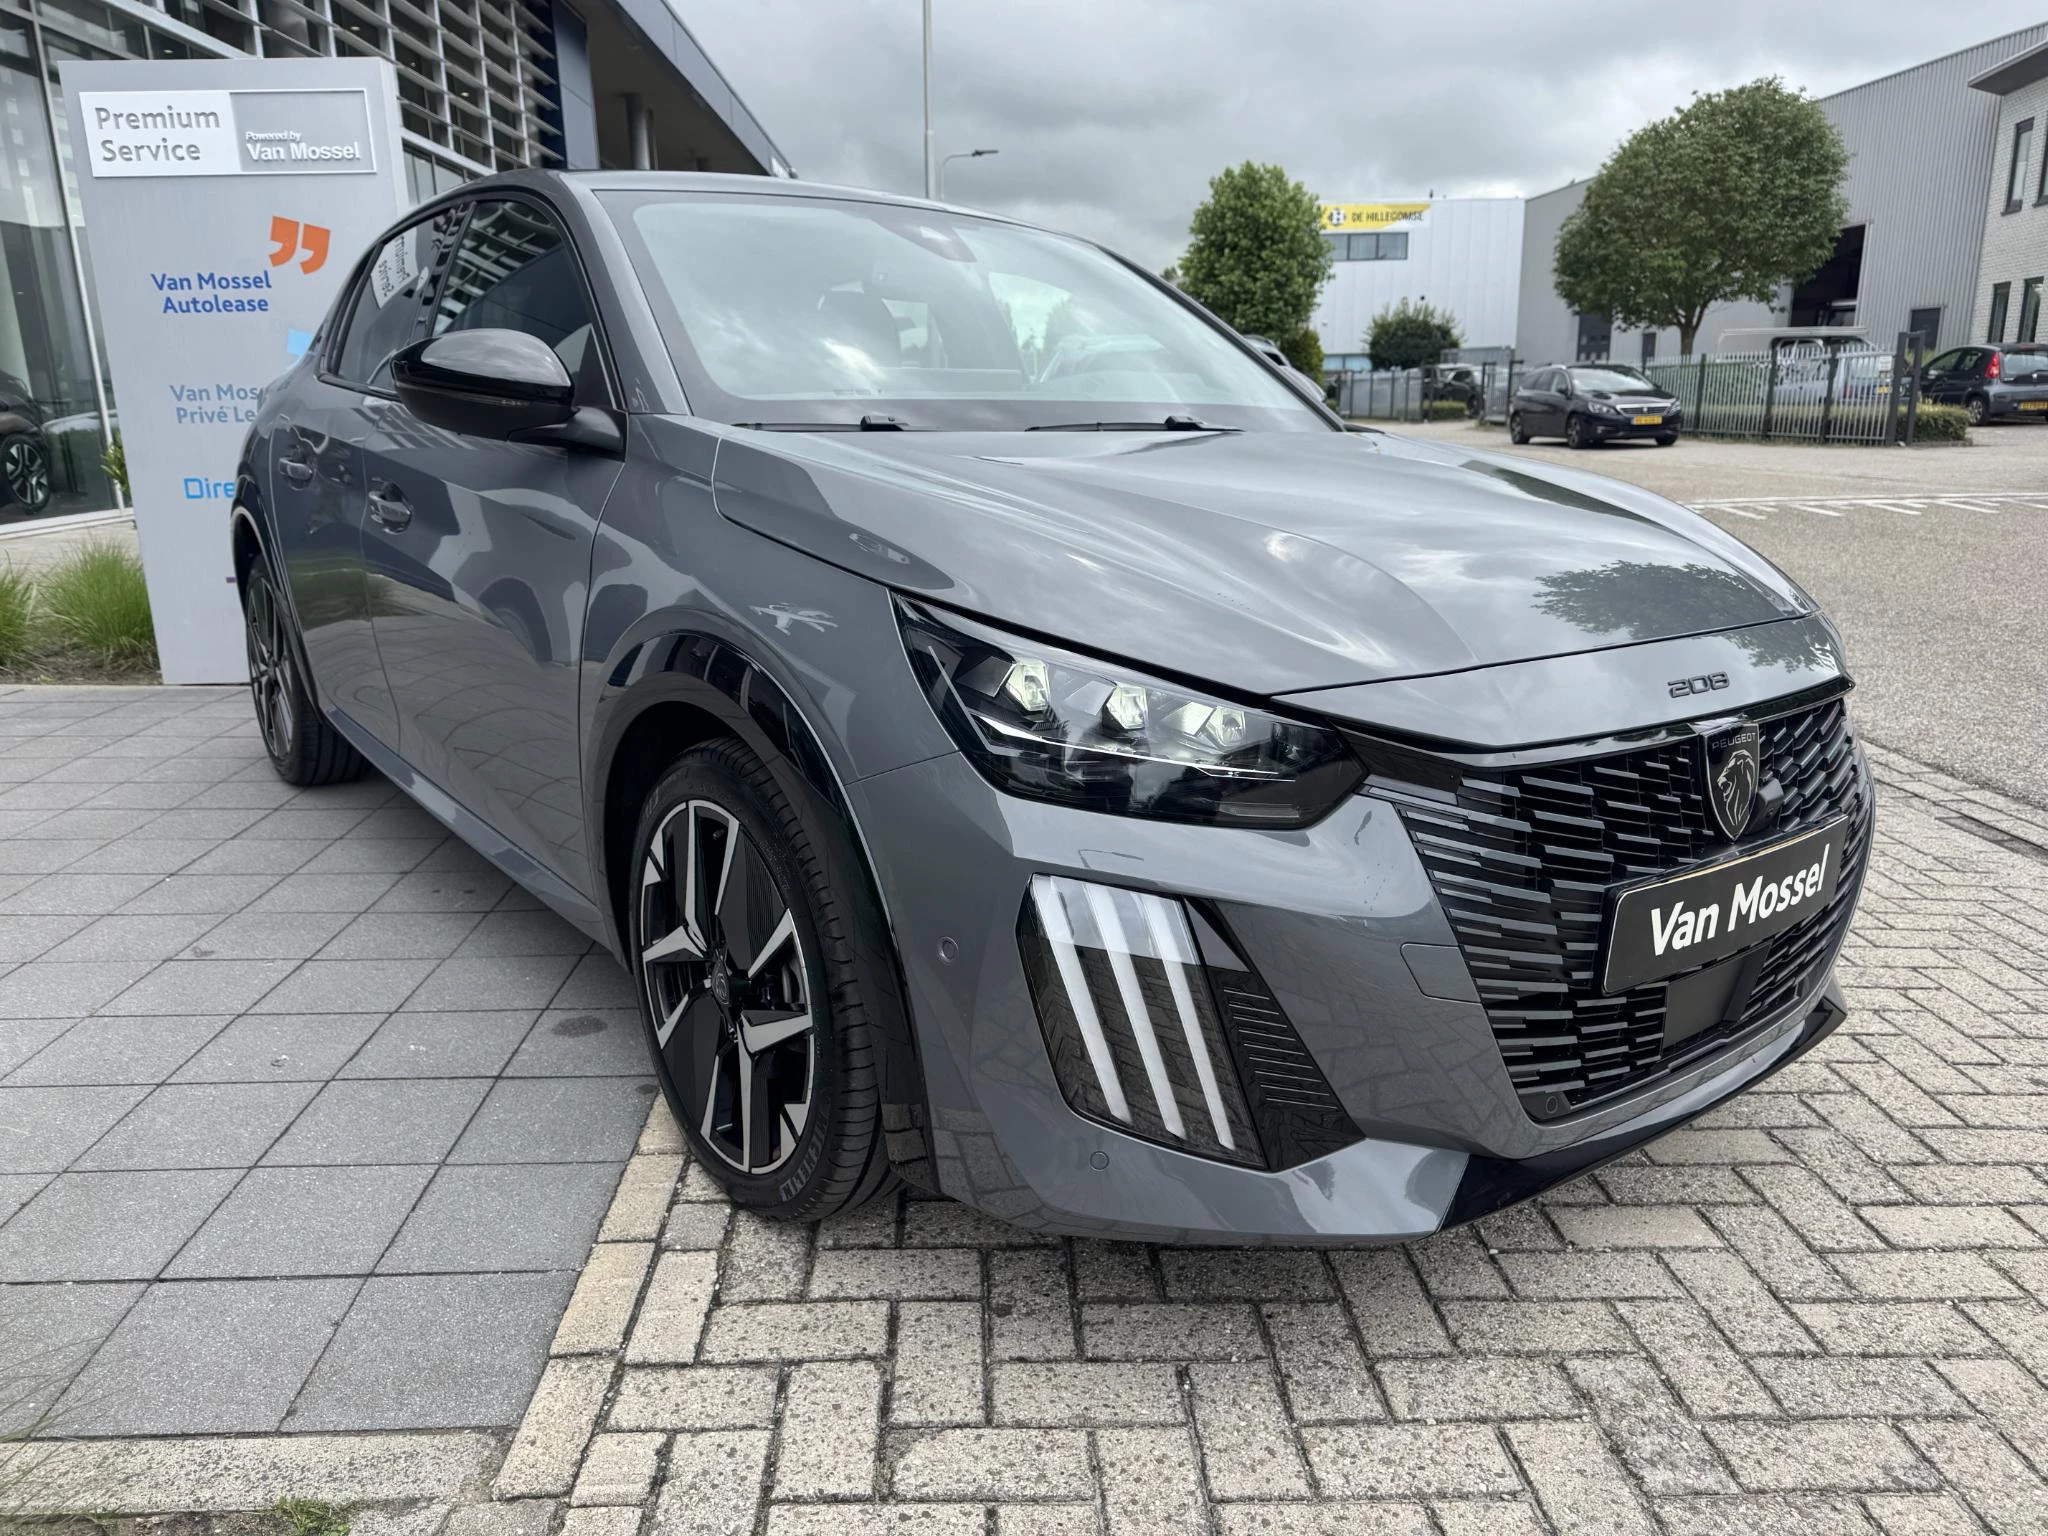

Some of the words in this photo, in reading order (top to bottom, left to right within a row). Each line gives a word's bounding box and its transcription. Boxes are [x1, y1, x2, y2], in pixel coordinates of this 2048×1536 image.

[94, 104, 221, 131] Premium
[245, 130, 286, 142] Powered
[287, 131, 302, 143] by
[100, 138, 202, 163] Service
[247, 143, 286, 162] Van
[290, 141, 361, 161] Mossel
[1351, 211, 1363, 223] DE
[151, 273, 192, 292] Van
[197, 270, 272, 290] Mossel
[162, 295, 269, 314] Autolease
[169, 384, 211, 402] Van
[216, 383, 259, 401] Mos
[176, 405, 229, 425] Privé
[183, 477, 236, 500] Dire
[1667, 672, 1730, 699] 208
[1711, 732, 1757, 752] PEUGEOT
[1650, 900, 1720, 956] Van
[1727, 843, 1830, 932] Mossel
